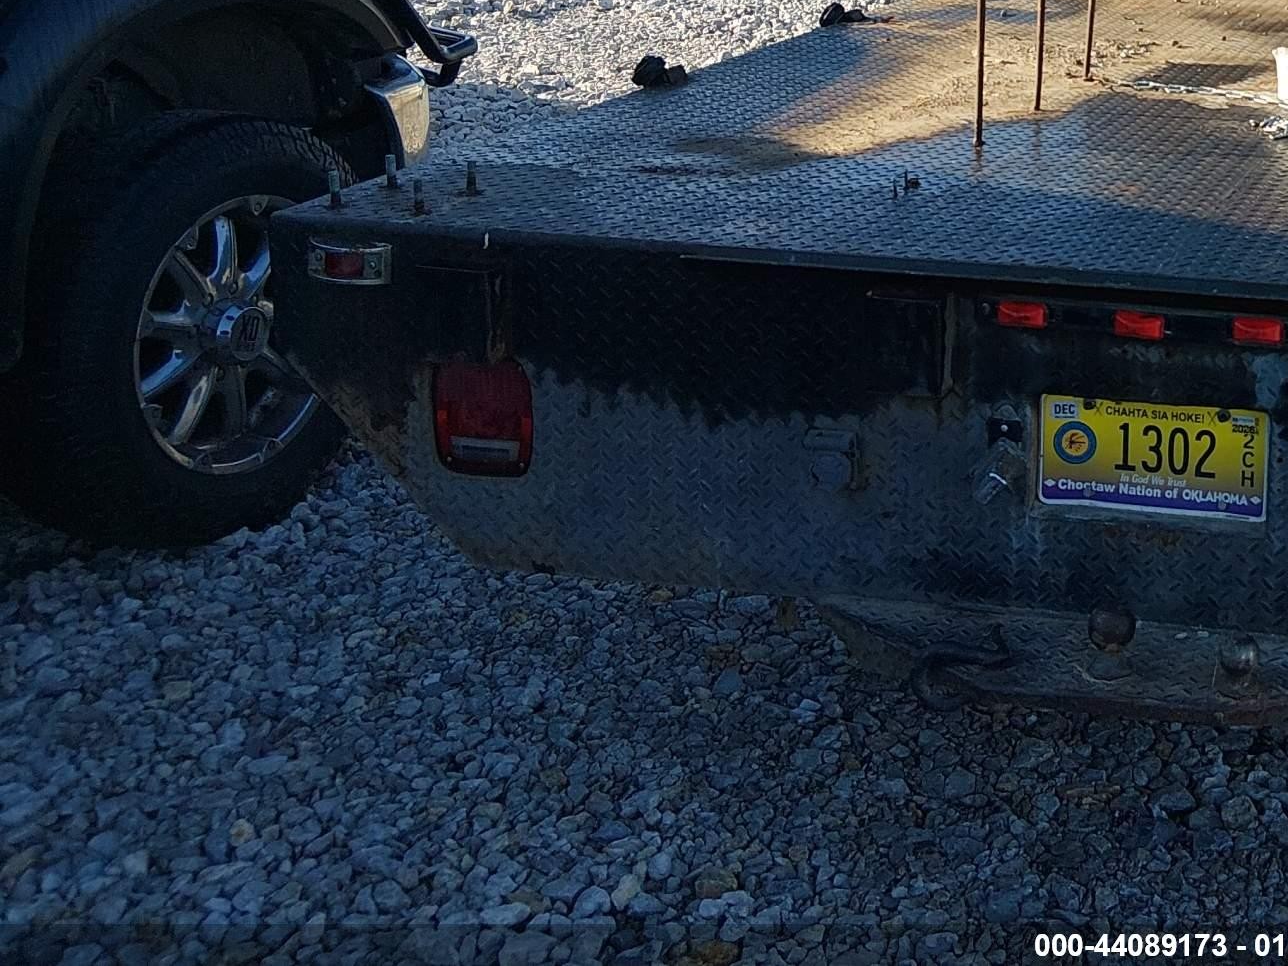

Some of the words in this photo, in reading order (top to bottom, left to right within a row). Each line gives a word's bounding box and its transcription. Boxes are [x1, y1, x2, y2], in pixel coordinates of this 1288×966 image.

[1054, 404, 1075, 415] DEC
[1105, 405, 1149, 419] CHAHTA
[1151, 409, 1169, 421] SIA
[1171, 410, 1205, 424] HOKE!
[1114, 422, 1216, 479] 1302
[1120, 474, 1130, 483] In
[1131, 474, 1149, 484] God
[1150, 475, 1165, 485] We
[1167, 476, 1187, 487] Trust
[1058, 479, 1115, 494] Choctaw
[1118, 483, 1161, 499] Nation
[1165, 487, 1179, 499] of
[1182, 488, 1248, 506] OKLAHOMA
